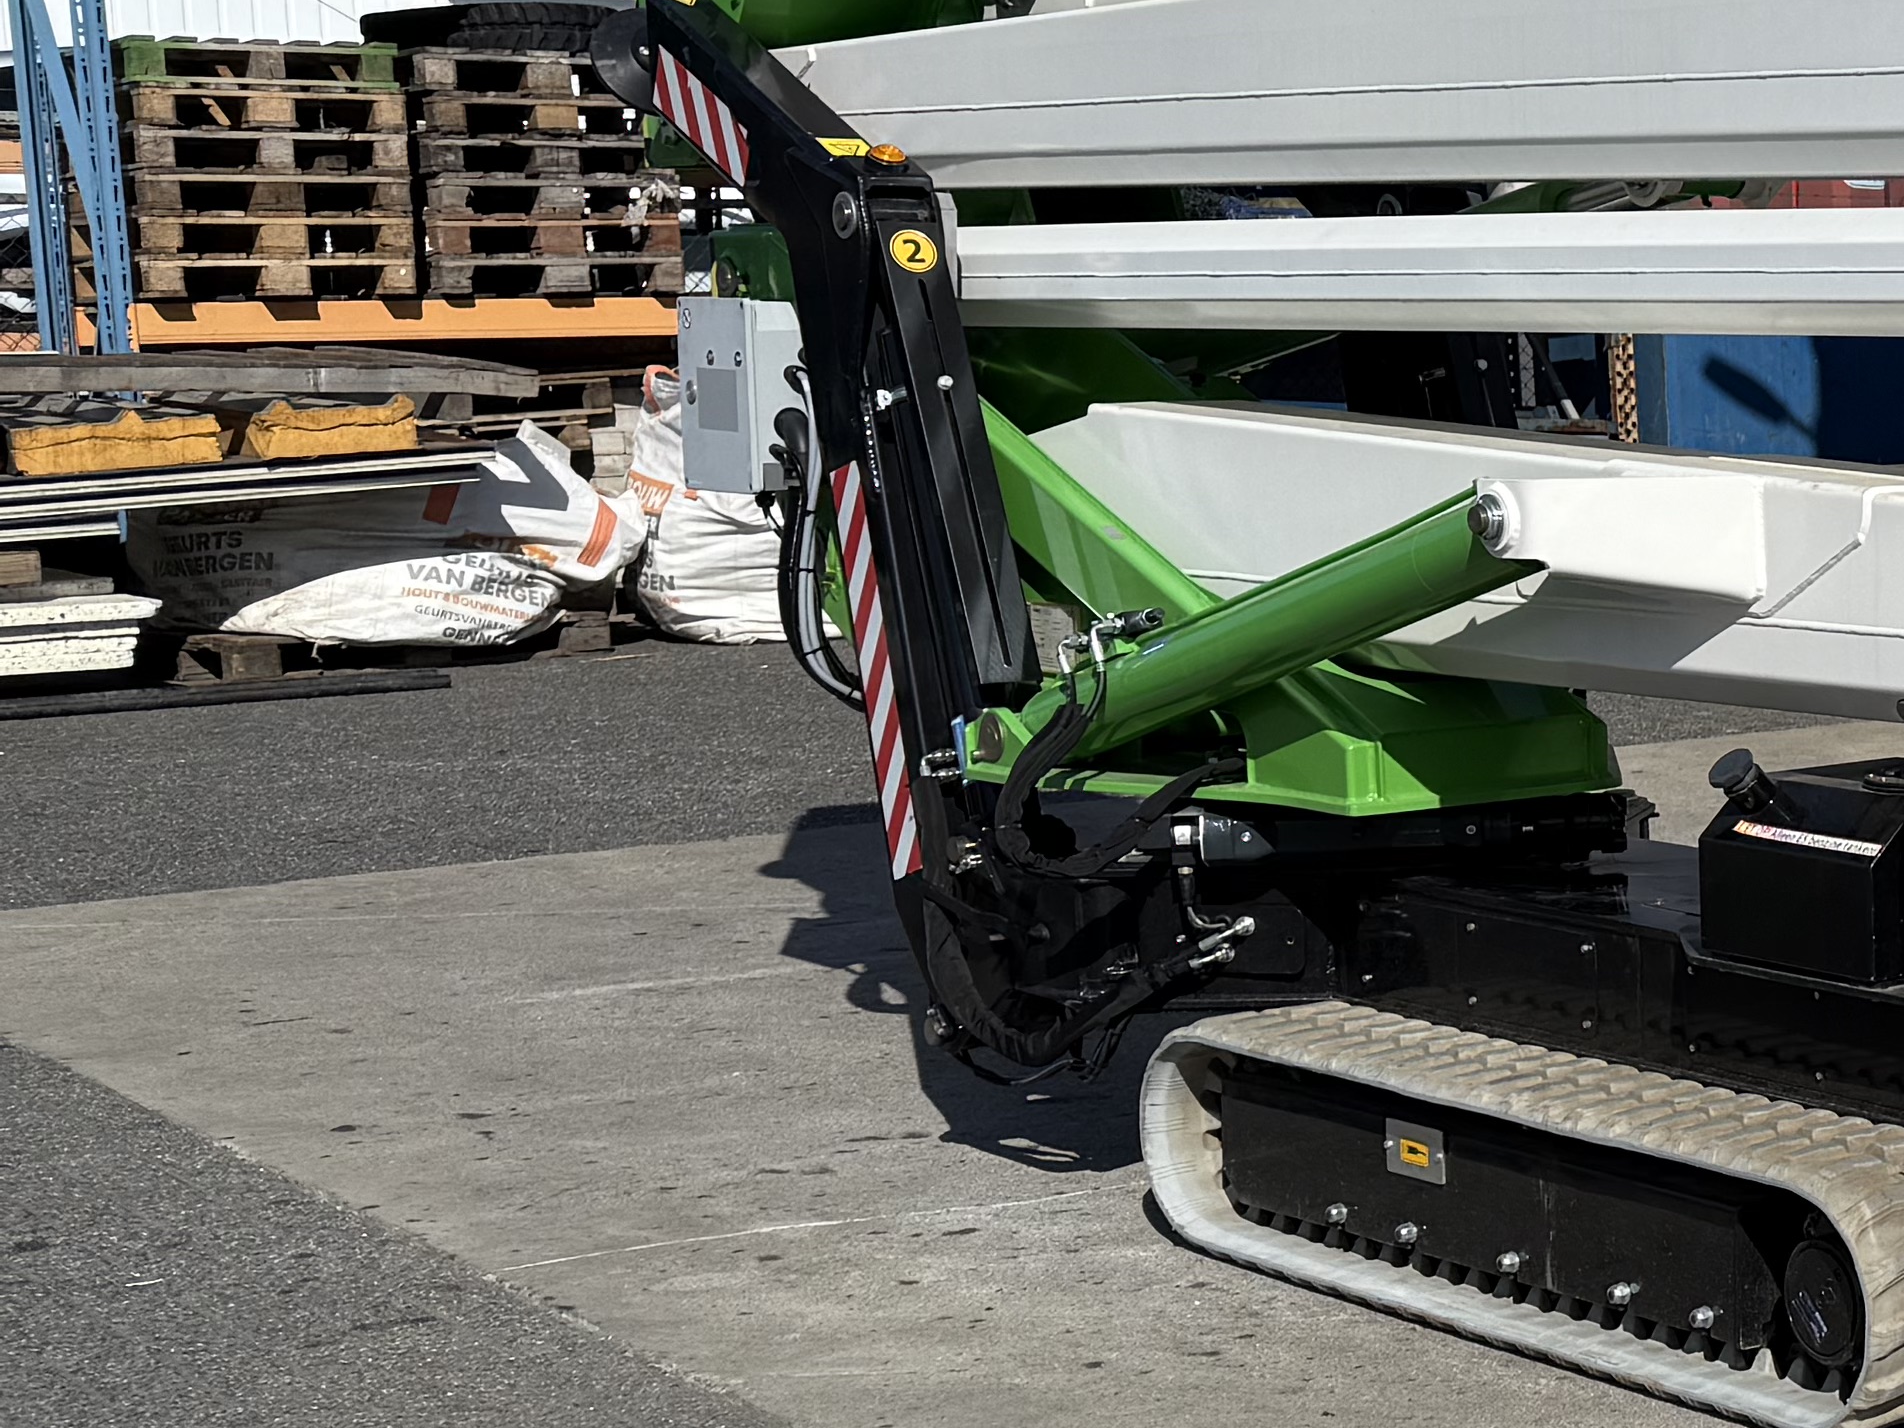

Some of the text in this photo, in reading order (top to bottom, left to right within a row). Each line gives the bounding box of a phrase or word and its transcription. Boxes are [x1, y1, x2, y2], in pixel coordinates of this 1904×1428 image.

[902, 238, 926, 263] 2
[406, 563, 554, 609] VAN BERGEN
